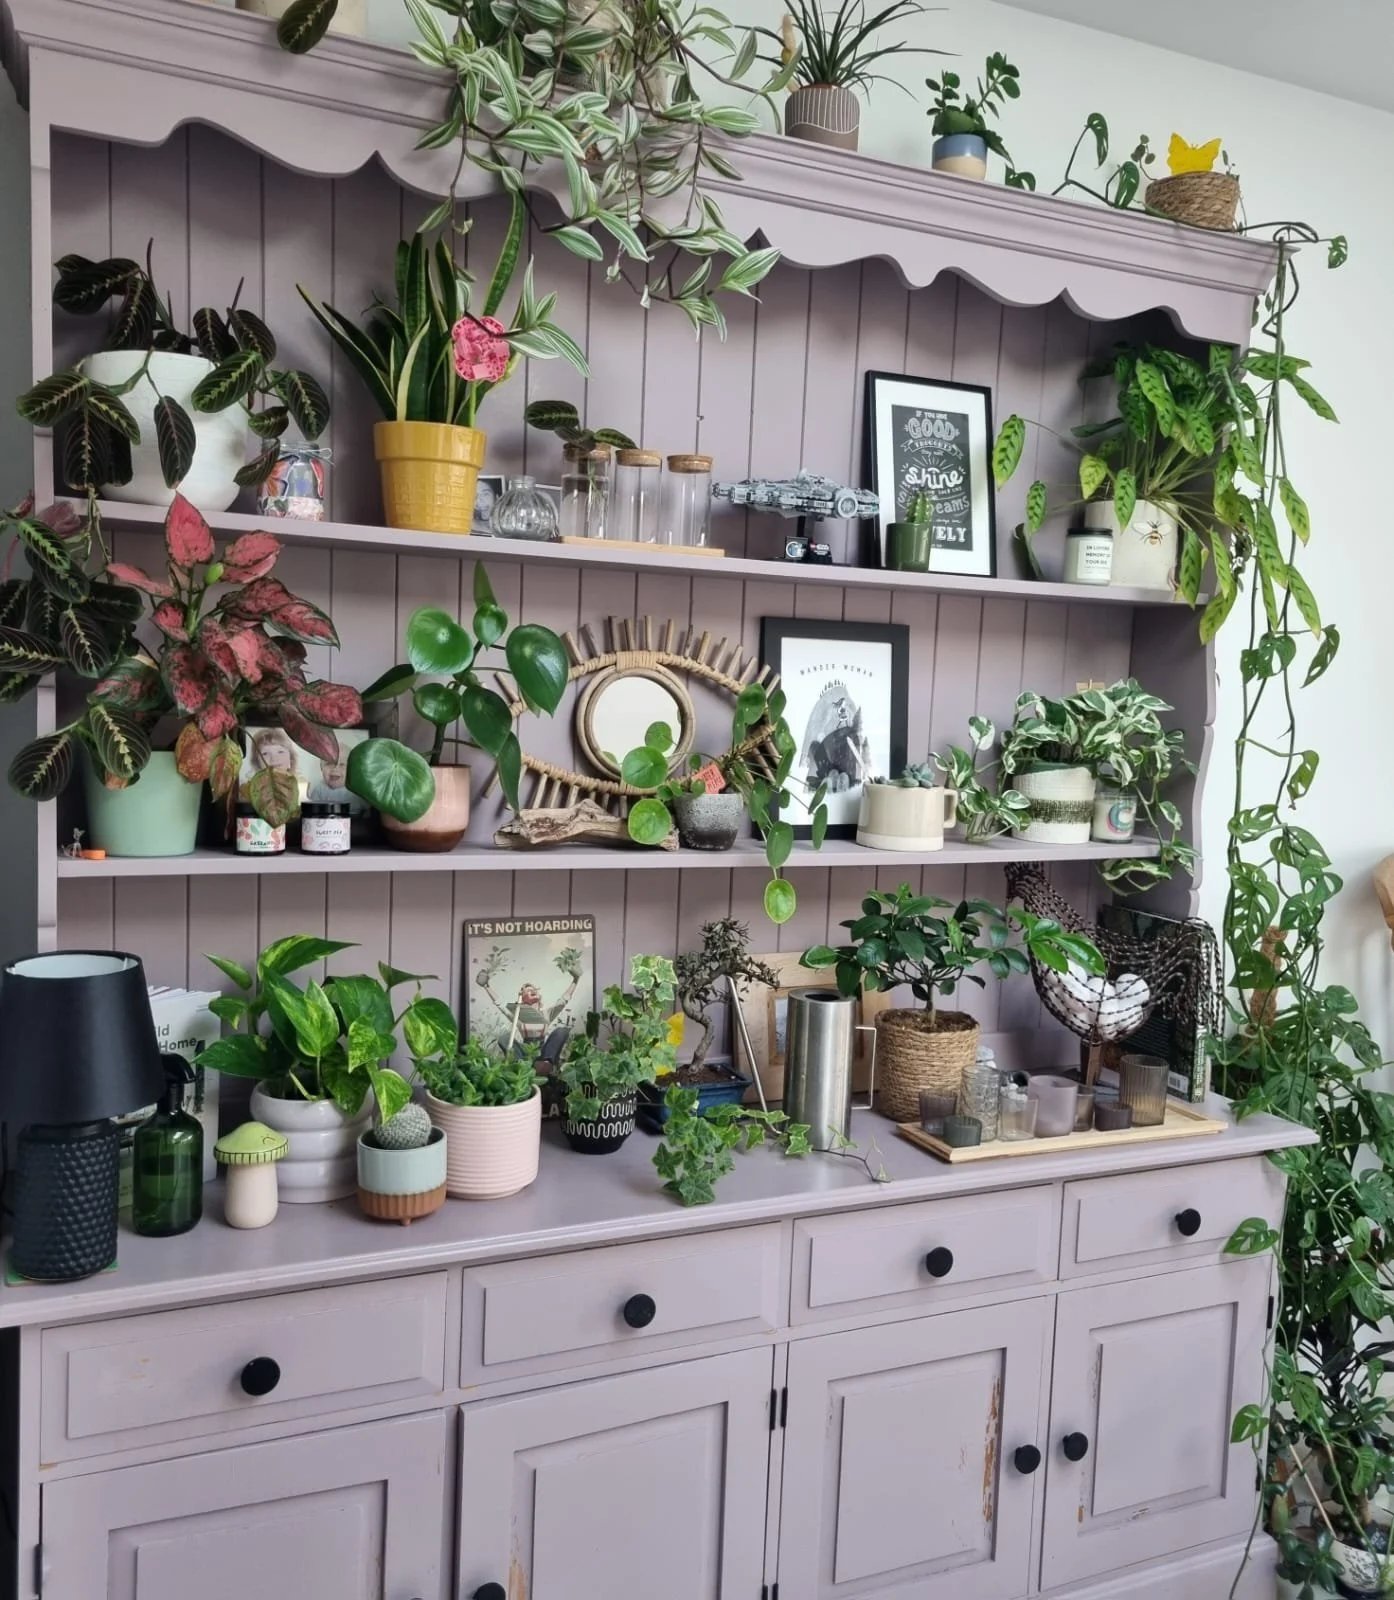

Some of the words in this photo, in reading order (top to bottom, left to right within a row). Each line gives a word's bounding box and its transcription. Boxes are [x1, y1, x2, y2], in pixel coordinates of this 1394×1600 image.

[907, 417, 956, 441] GOOD
[467, 923, 493, 935] IT'S
[495, 921, 523, 934] NOT
[525, 919, 592, 932] HOARDING
[157, 1023, 170, 1038] ld
[158, 1037, 197, 1053] Home
